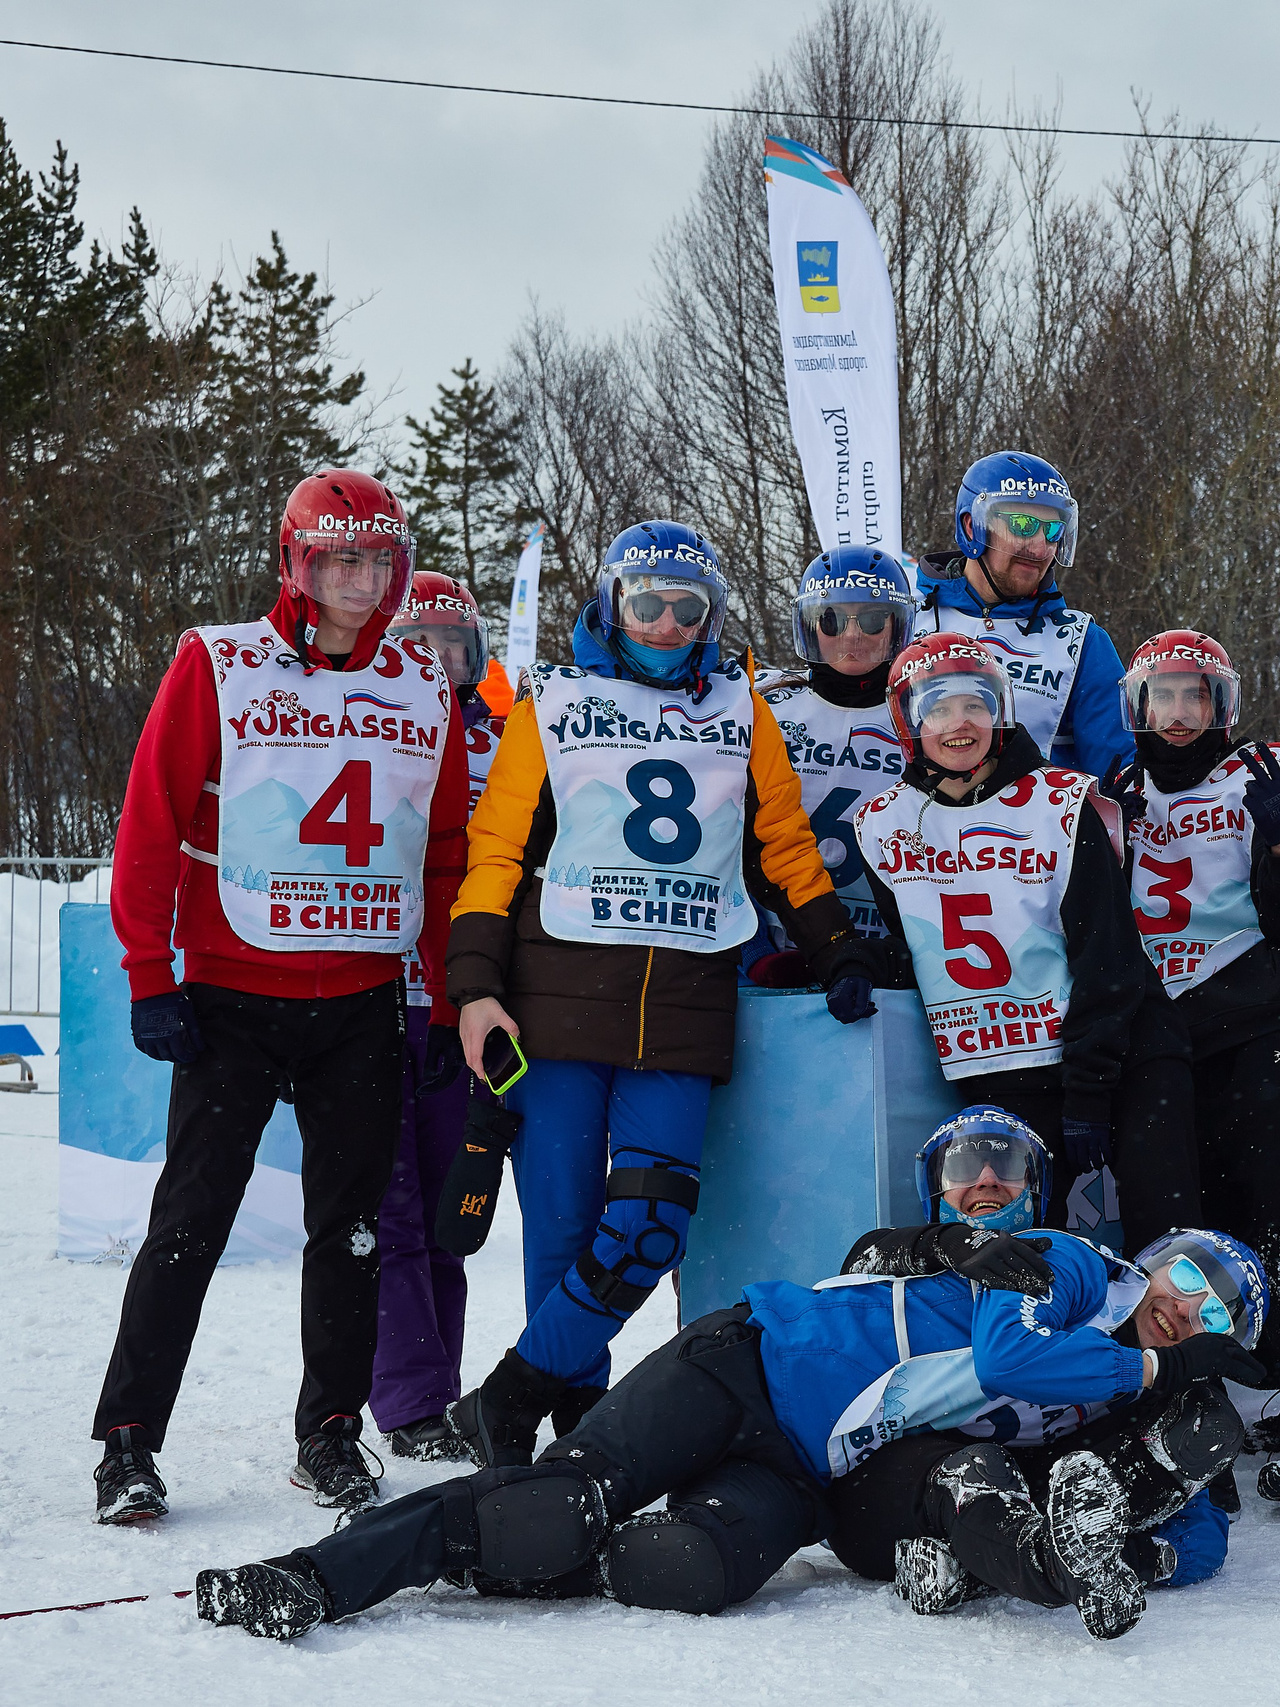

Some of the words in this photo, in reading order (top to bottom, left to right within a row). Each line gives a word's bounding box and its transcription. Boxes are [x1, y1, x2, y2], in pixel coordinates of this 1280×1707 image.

[265, 741, 302, 749] MURMANSK
[392, 747, 423, 759] СНЕЖНЫЙ
[424, 752, 436, 761] БОЙ
[581, 742, 619, 750] MURMANSK
[620, 743, 647, 751] REGION
[802, 768, 828, 776] REGION
[299, 760, 385, 867] 4
[623, 759, 702, 865] 8
[810, 787, 867, 889] 6
[270, 880, 299, 893] ДЛЯ
[302, 880, 328, 892] ТЕХ,
[334, 883, 402, 903] ТОЛК
[270, 893, 294, 901] КТО
[294, 893, 329, 902] ЗНАЕТ
[591, 874, 621, 887] ДЛЯ
[623, 875, 649, 887] ТЕХ,
[655, 878, 720, 904] ТОЛК
[591, 886, 614, 895] КТО
[614, 887, 648, 896] ЗНАЕТ
[1133, 853, 1194, 935] 3
[270, 904, 291, 929] В
[300, 906, 401, 932] СНЕГЕ
[591, 897, 612, 921] В
[620, 900, 716, 933] СНЕГЕ
[940, 893, 1012, 990] 5
[954, 1005, 978, 1018] ТЕХ,
[983, 998, 1059, 1021] ТОЛК
[947, 1016, 979, 1029] ЗНАЕТ
[956, 1016, 1062, 1054] СНЕГЕ
